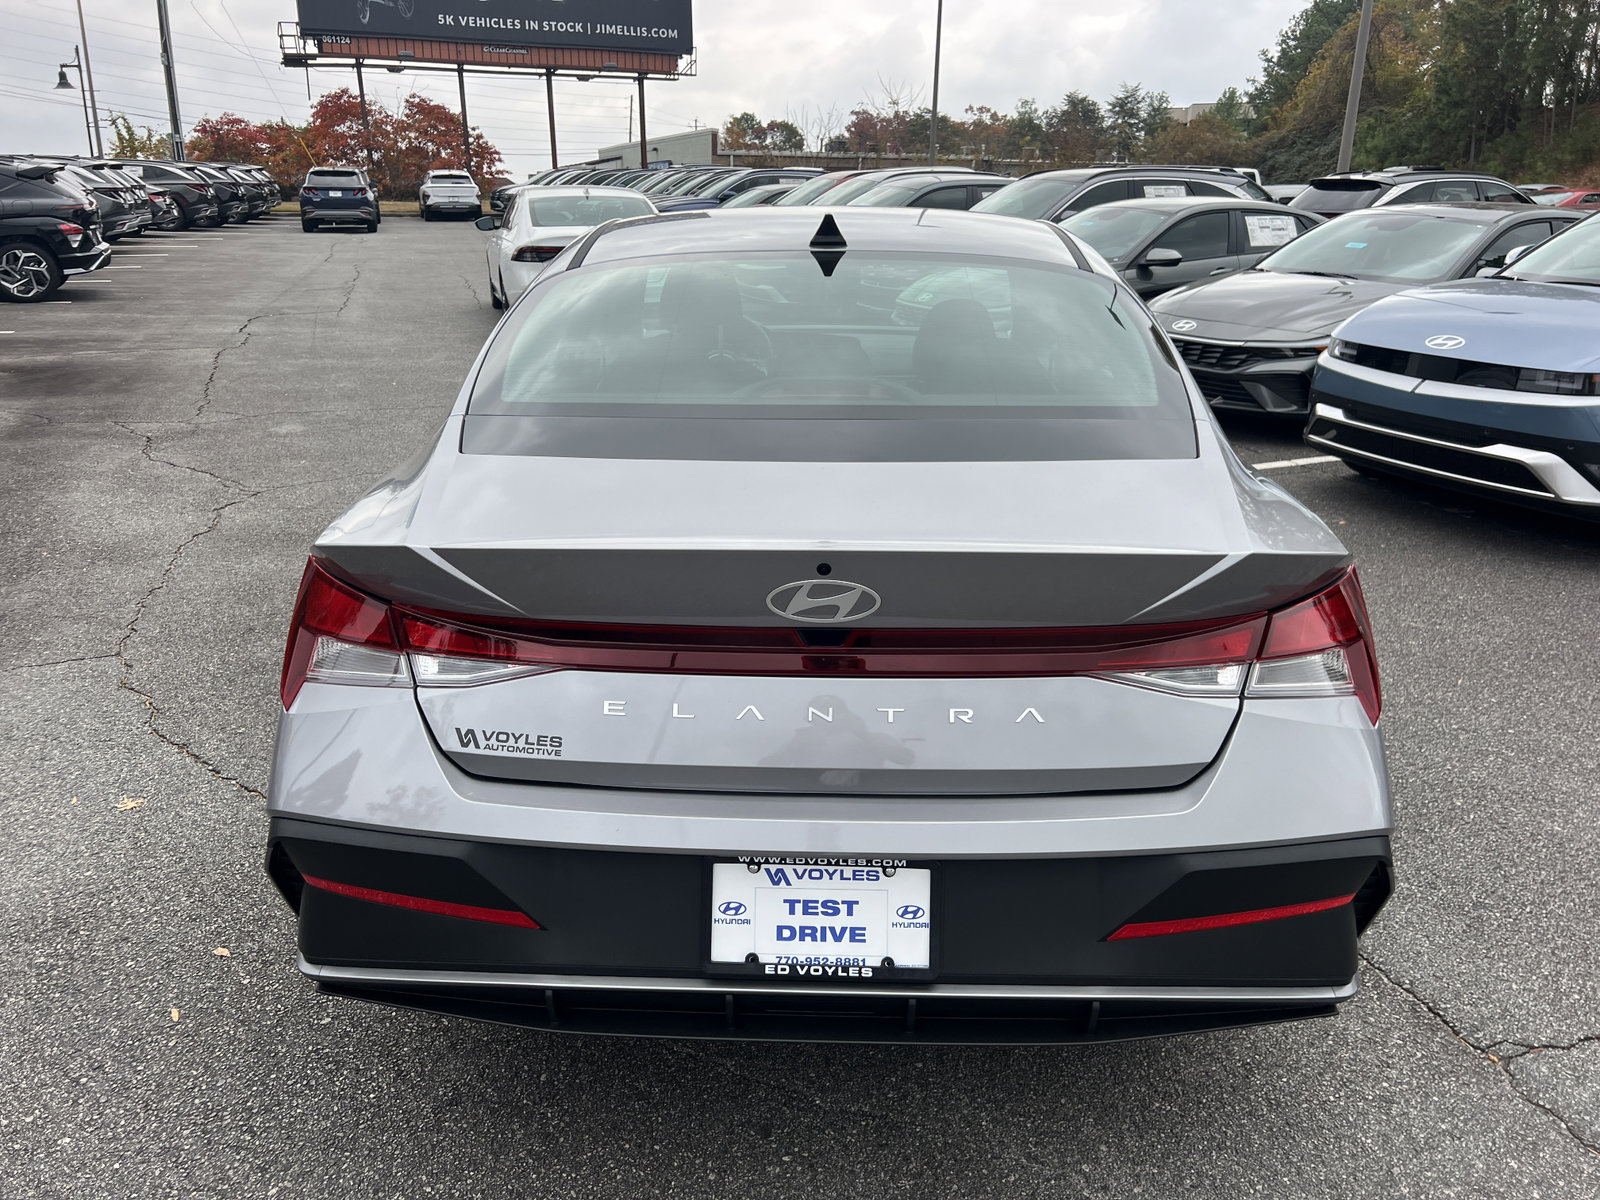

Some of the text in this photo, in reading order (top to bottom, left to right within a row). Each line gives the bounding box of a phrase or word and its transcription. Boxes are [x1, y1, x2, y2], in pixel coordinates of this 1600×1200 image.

[438, 14, 455, 26] 5K
[459, 16, 521, 29] VEHICLES
[525, 20, 539, 31] IN
[543, 21, 584, 33] STOCK
[595, 24, 679, 39] JIMELLIS.COM
[322, 35, 351, 44] 061124
[602, 700, 1046, 724] ELANTRA
[482, 730, 563, 748] VOYLES
[483, 743, 562, 757] AUTOMOTIVE
[738, 855, 907, 867] WWW.EDVOYLES.COM
[792, 867, 881, 882] VOYLES
[783, 899, 860, 917] TEST
[713, 918, 751, 926] HYUNDAI
[891, 921, 930, 929] HYUNDAI
[776, 925, 867, 943] DRIVE
[775, 956, 866, 967] 770-952-8881
[764, 964, 873, 977] ED VOYLES
